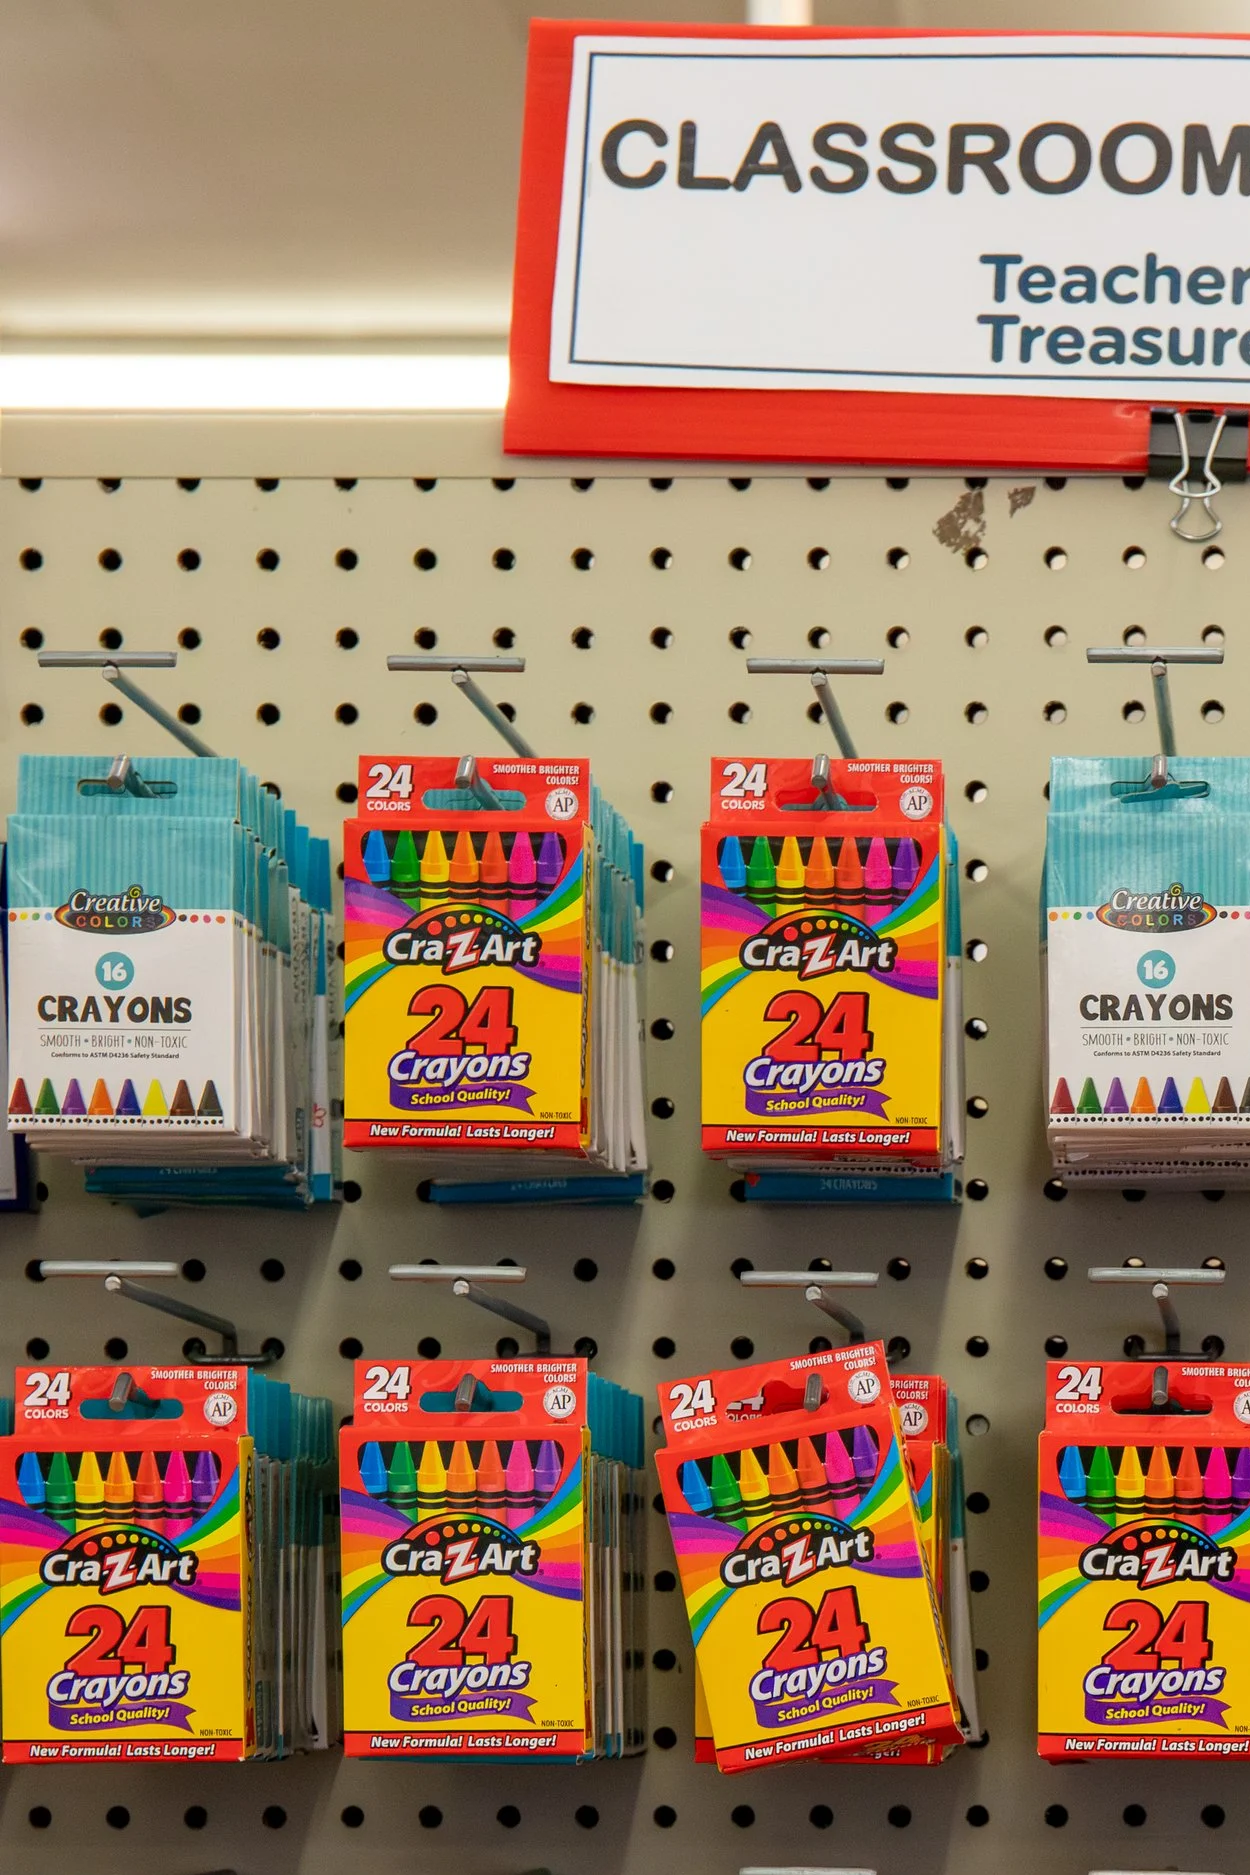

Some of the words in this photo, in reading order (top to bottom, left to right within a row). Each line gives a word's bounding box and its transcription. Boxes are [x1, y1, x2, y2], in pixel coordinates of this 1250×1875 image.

[71, 884, 162, 913] Creative
[1112, 884, 1202, 911] Creative
[1116, 914, 1197, 927] COLORS
[101, 961, 127, 981] 16
[1143, 960, 1169, 980] 16
[37, 995, 192, 1024] CRAYONS
[1079, 993, 1233, 1021] CRAYONS
[763, 989, 874, 1060] 24
[40, 1034, 81, 1048] SMOOTH
[91, 1035, 125, 1048] BRIGHT
[134, 1036, 188, 1049] NON-TOXIC
[1082, 1033, 1123, 1046] SMOOTH
[1133, 1033, 1167, 1046] BRIGHT
[1176, 1032, 1229, 1046] NON-TOXIC
[51, 1051, 81, 1059] Conforms
[1172, 1050, 1191, 1058] Safety
[745, 1057, 885, 1092] Crayons
[410, 1089, 455, 1105] School
[456, 1089, 510, 1102] Quality!
[540, 1111, 572, 1120] NON-TOXIC
[1181, 1366, 1225, 1377] SMOOTHER
[669, 1378, 716, 1421] 24
[672, 1414, 719, 1434] COLORS
[65, 1603, 177, 1675] 24
[751, 1645, 885, 1701] Crayons
[48, 1670, 188, 1706] Crayons
[370, 1736, 401, 1749] New
[402, 1735, 463, 1749] Formula!
[468, 1736, 502, 1748] Lasts
[505, 1735, 557, 1749] Longer!
